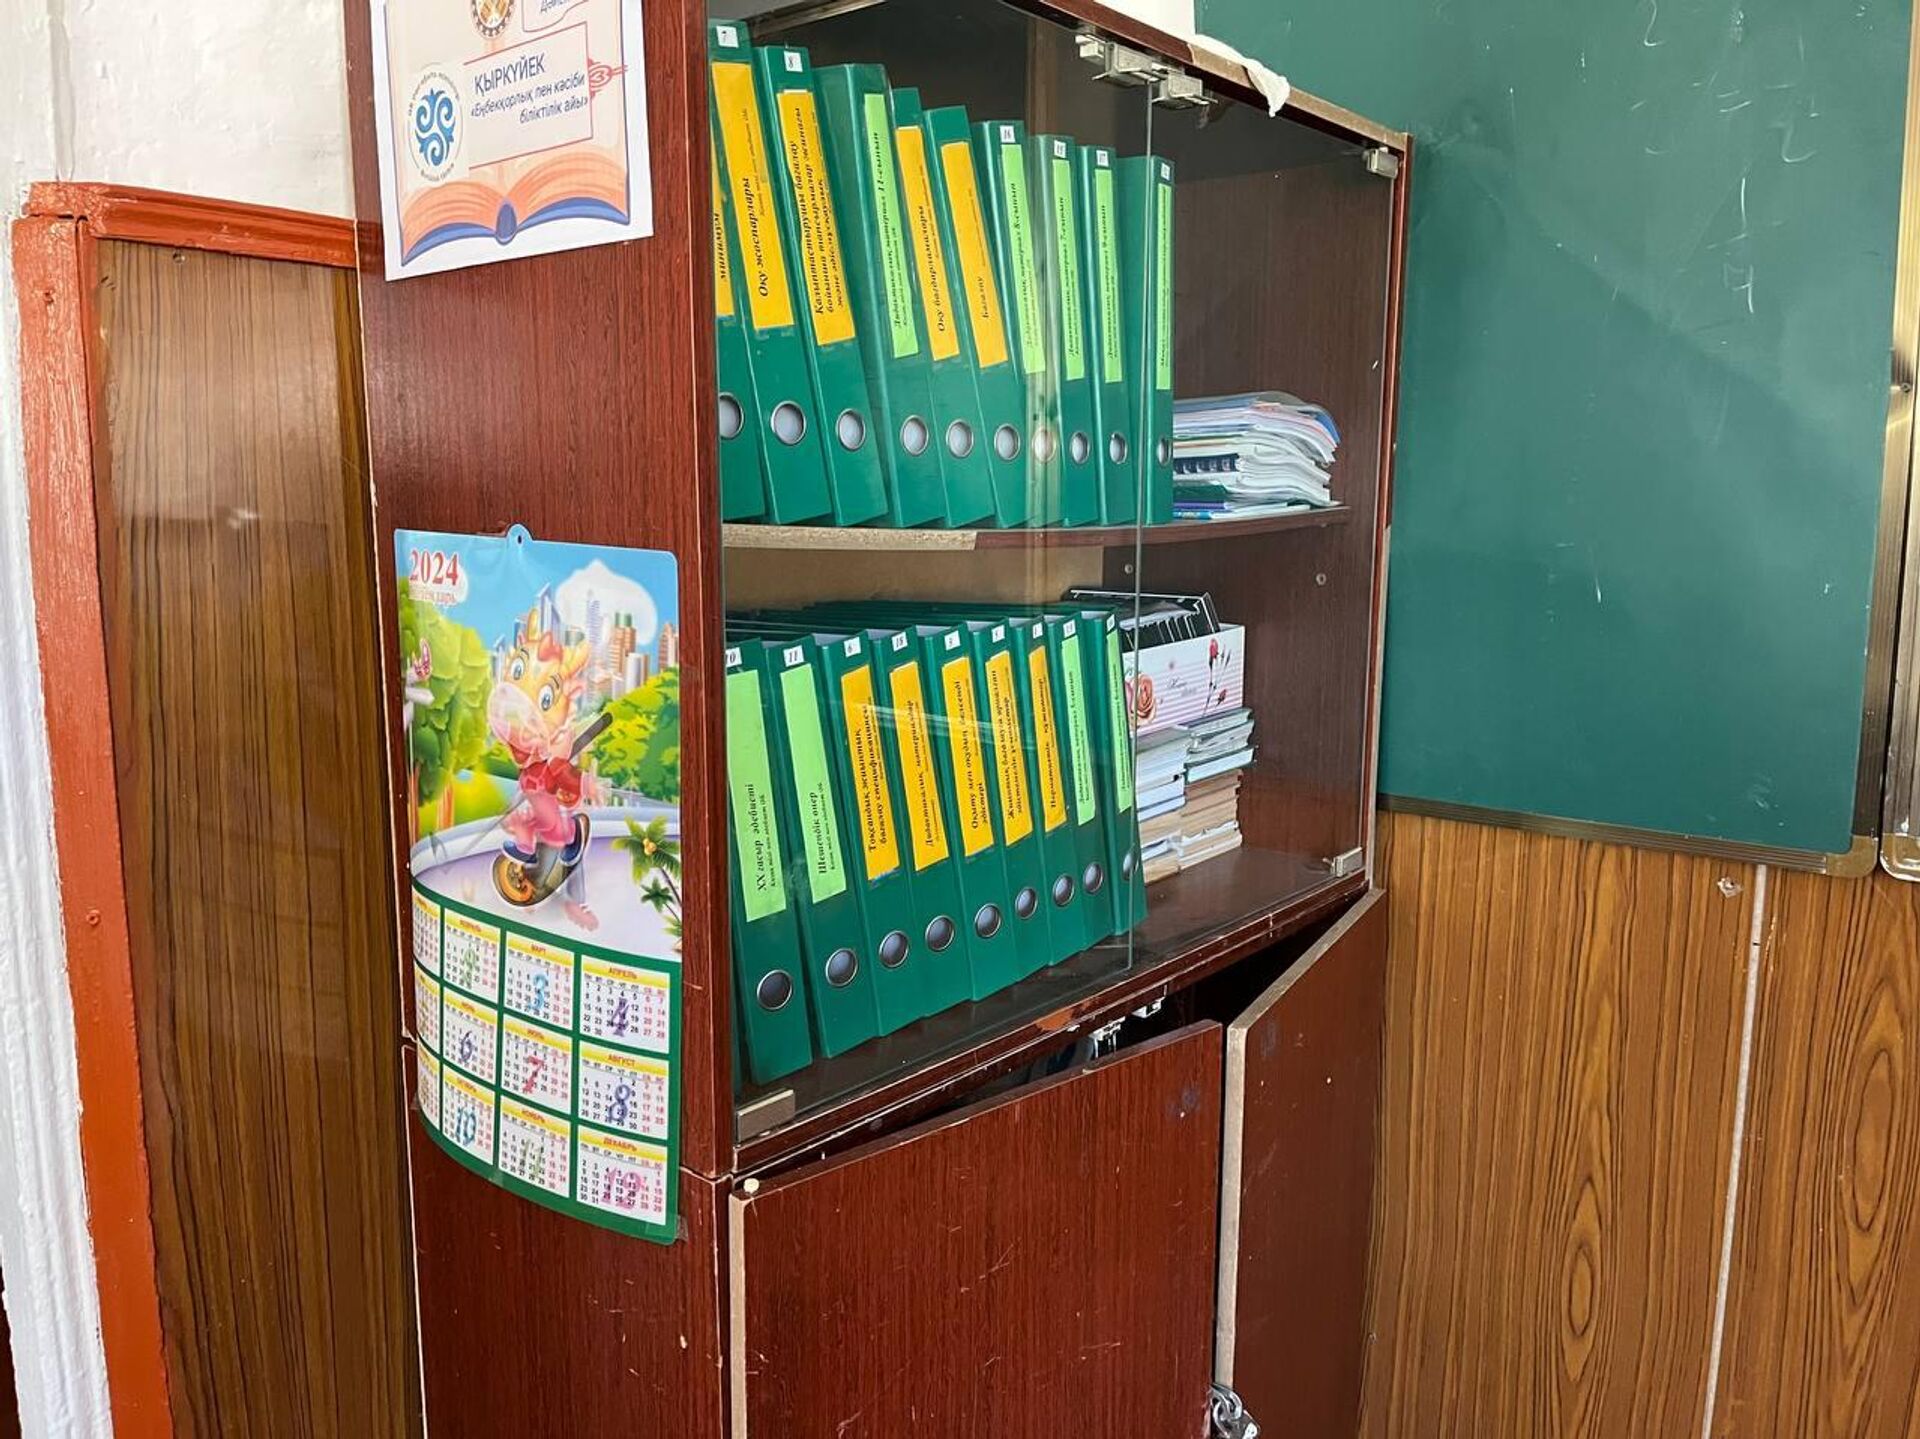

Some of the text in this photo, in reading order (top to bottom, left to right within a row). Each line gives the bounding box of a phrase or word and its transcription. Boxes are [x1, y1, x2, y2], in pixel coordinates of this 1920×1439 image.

[474, 52, 545, 97] ҚЫРКҮЙЕК
[534, 84, 553, 101] пен
[553, 72, 586, 95] кәсіби
[519, 102, 562, 124] біліктілік
[743, 178, 763, 267] жоспарлары
[409, 549, 459, 586] 2024
[814, 819, 826, 874] Шешендік
[608, 967, 637, 979] АПРЕЛЬ
[608, 1054, 635, 1067] АВГУСТ
[603, 1137, 638, 1152] ДЕКАБРЬ
